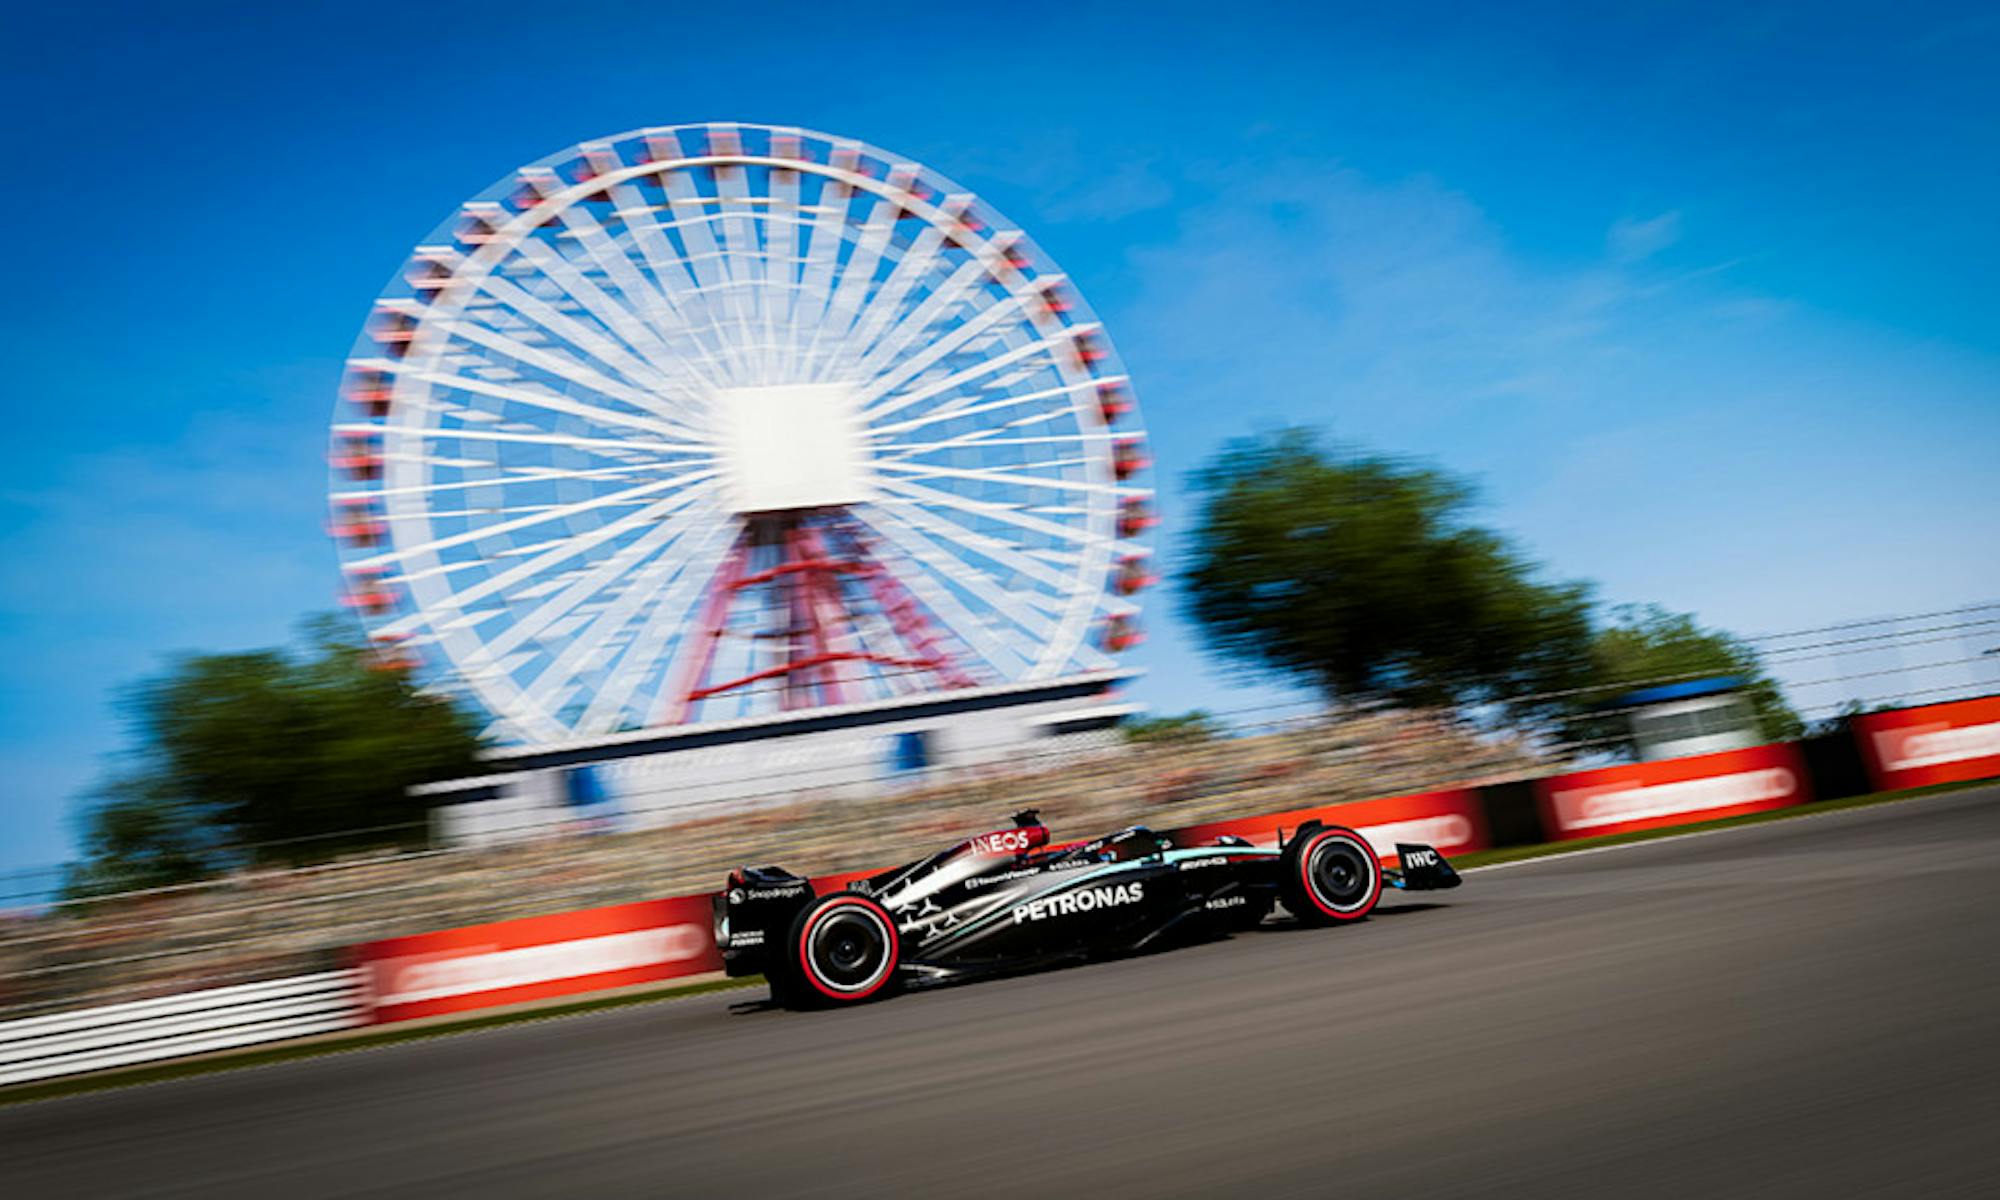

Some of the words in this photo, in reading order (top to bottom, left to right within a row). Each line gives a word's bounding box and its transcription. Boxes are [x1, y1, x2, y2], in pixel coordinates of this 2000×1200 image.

[970, 831, 1029, 855] INEOS
[1404, 849, 1439, 870] IWC
[748, 886, 805, 900] Snapdragon
[1013, 882, 1144, 925] PETRONAS
